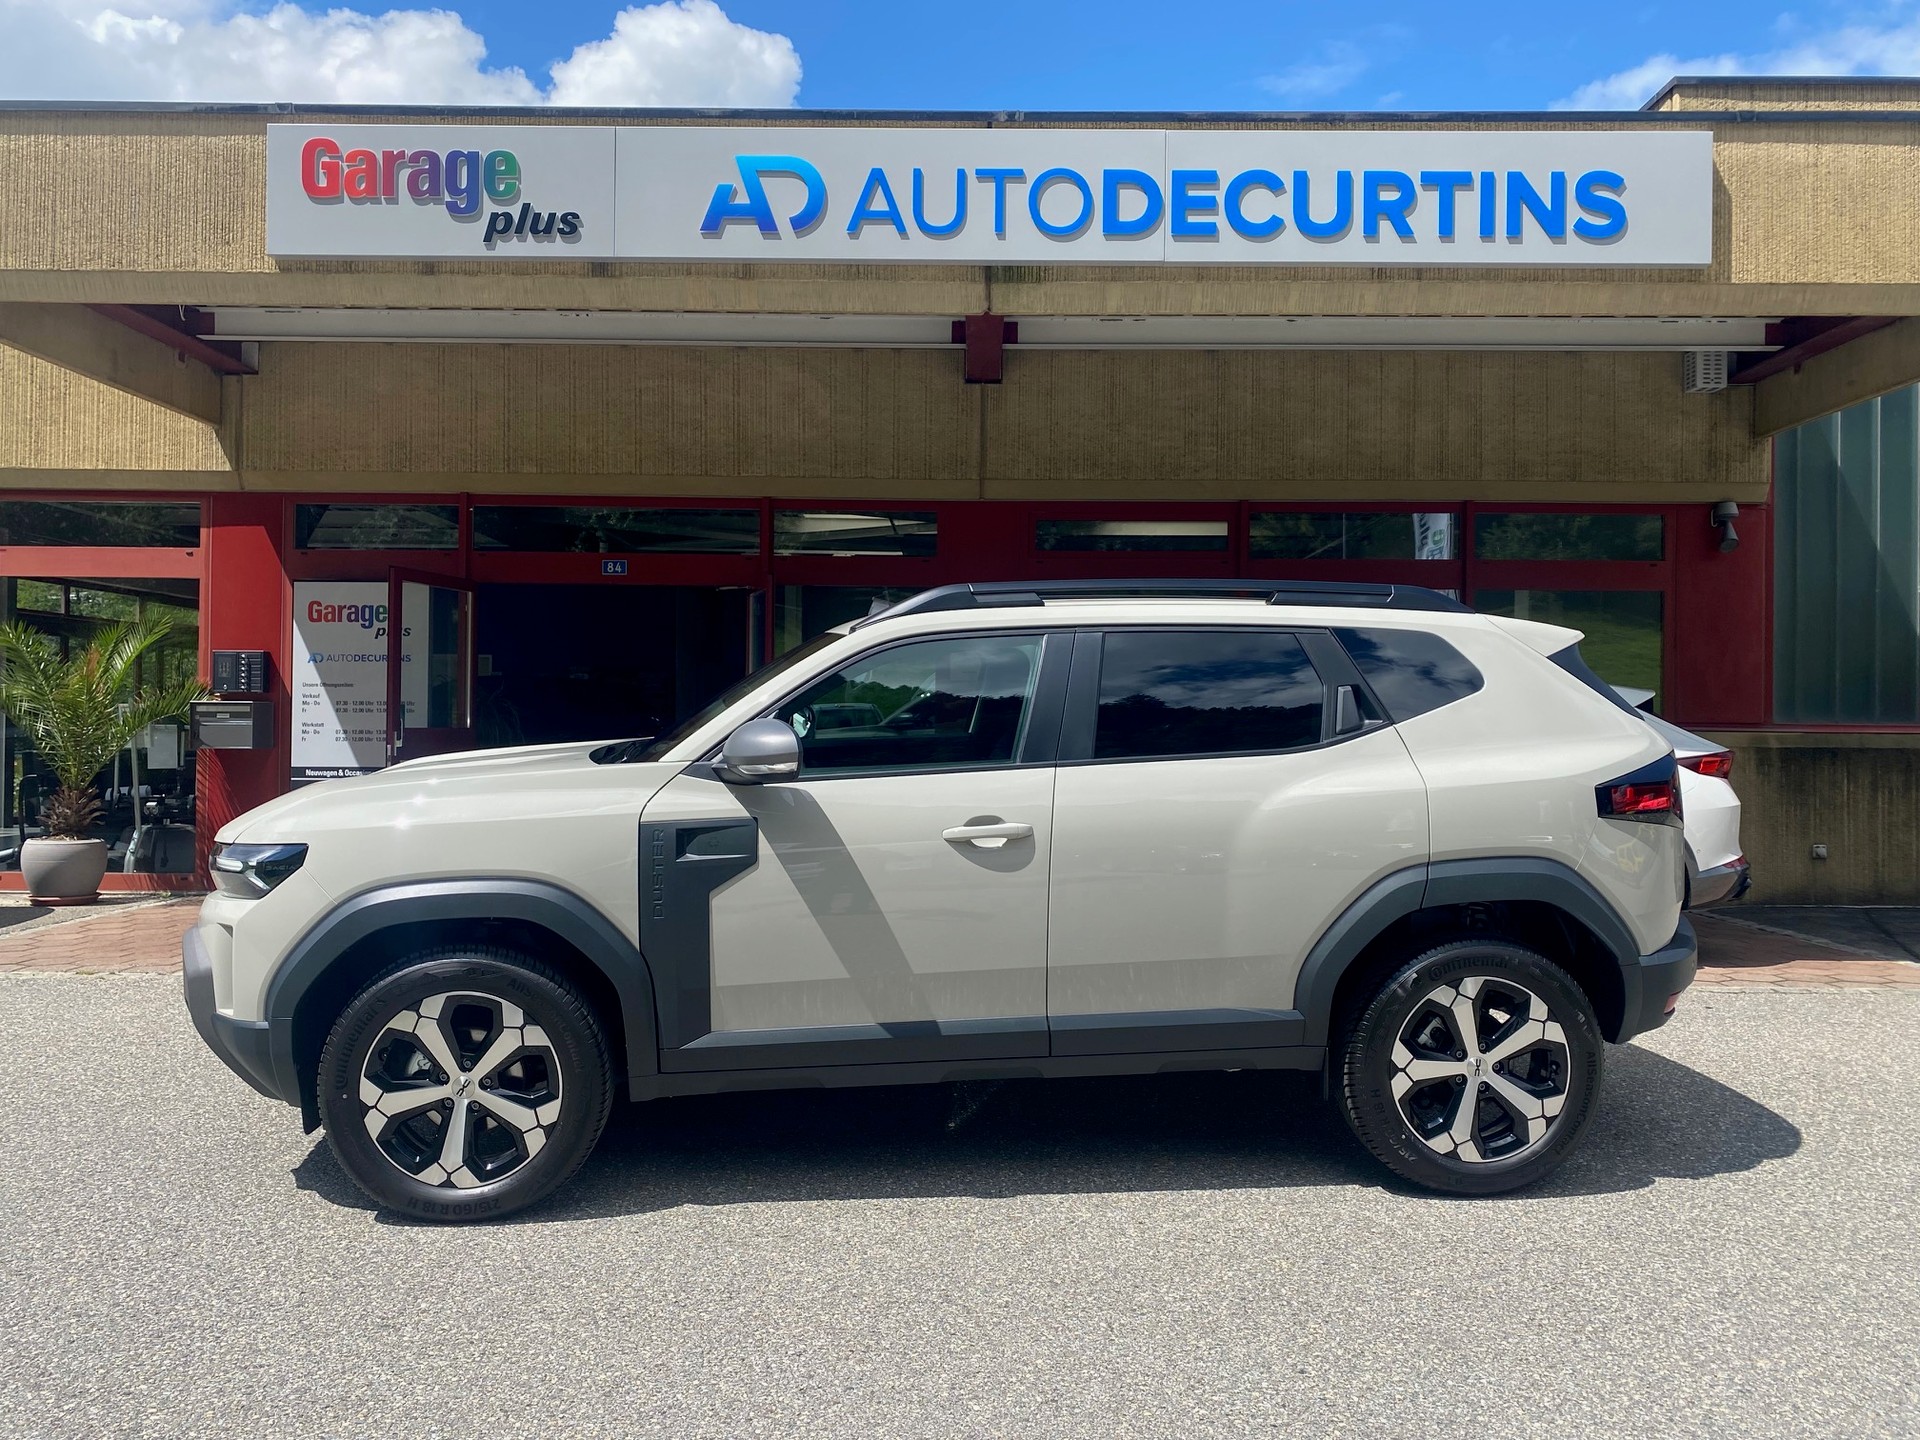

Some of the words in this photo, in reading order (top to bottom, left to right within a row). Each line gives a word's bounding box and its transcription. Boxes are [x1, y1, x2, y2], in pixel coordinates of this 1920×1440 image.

[300, 137, 519, 215] Garage
[847, 166, 1627, 242] AUTODECURTINS
[483, 202, 580, 244] plus
[607, 562, 621, 573] 84
[308, 600, 388, 629] Garage
[375, 627, 412, 639] ps
[305, 769, 338, 778] Neuwagen
[338, 769, 344, 777] &
[652, 829, 664, 919] DUSTER
